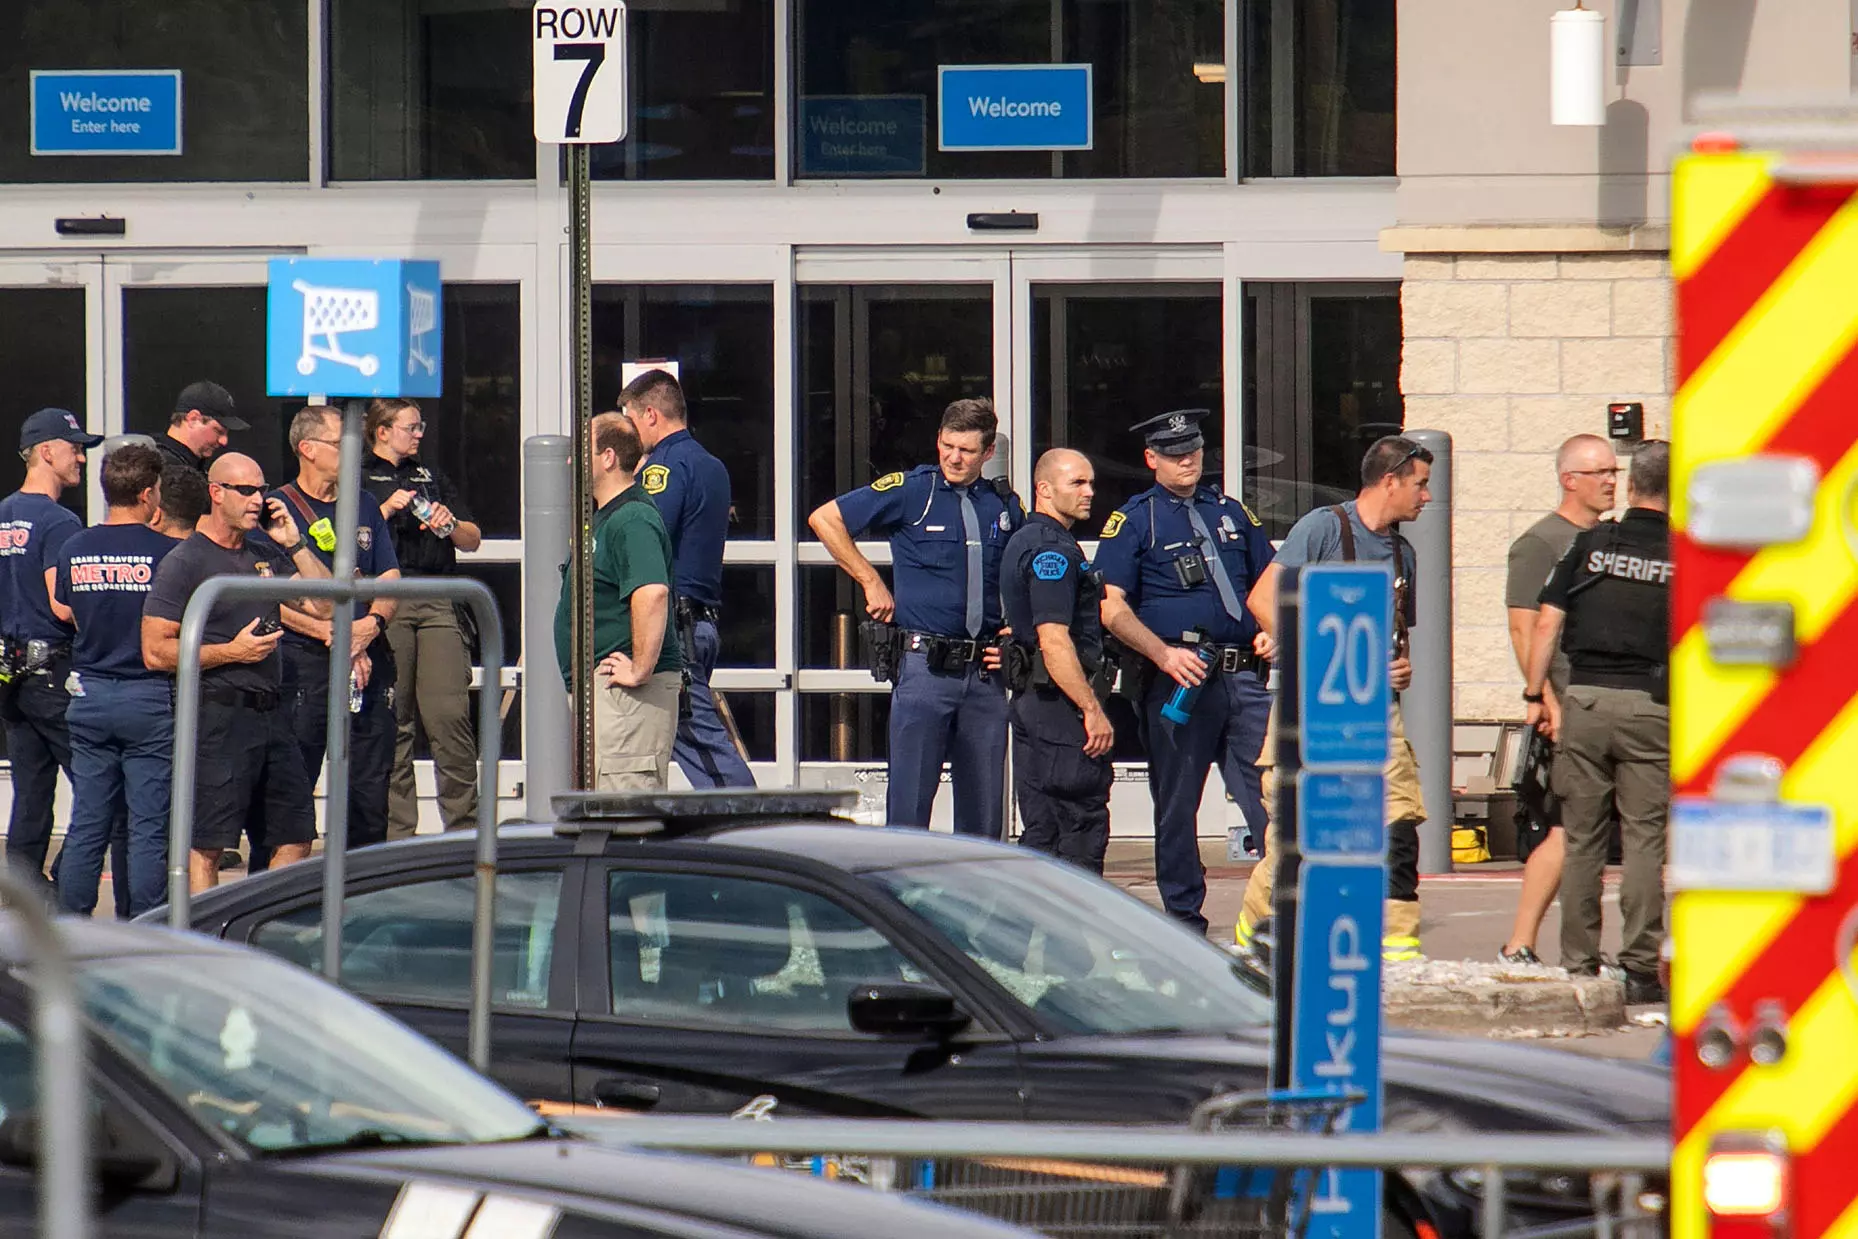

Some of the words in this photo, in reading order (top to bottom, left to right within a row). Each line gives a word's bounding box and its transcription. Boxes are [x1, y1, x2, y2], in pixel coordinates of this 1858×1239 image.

[537, 8, 618, 39] ROW
[553, 43, 605, 138] 7
[60, 92, 152, 112] Welcome
[968, 97, 1062, 118] Welcome
[71, 119, 107, 134] Enter
[110, 120, 141, 134] here
[809, 115, 898, 136] Welcome
[70, 556, 101, 565] GRAND
[102, 555, 153, 564] TRAVERSE
[1588, 551, 1676, 583] SHERIFF
[71, 564, 152, 585] METRO
[91, 583, 152, 592] DEPARTMENT
[1317, 611, 1379, 705] 20
